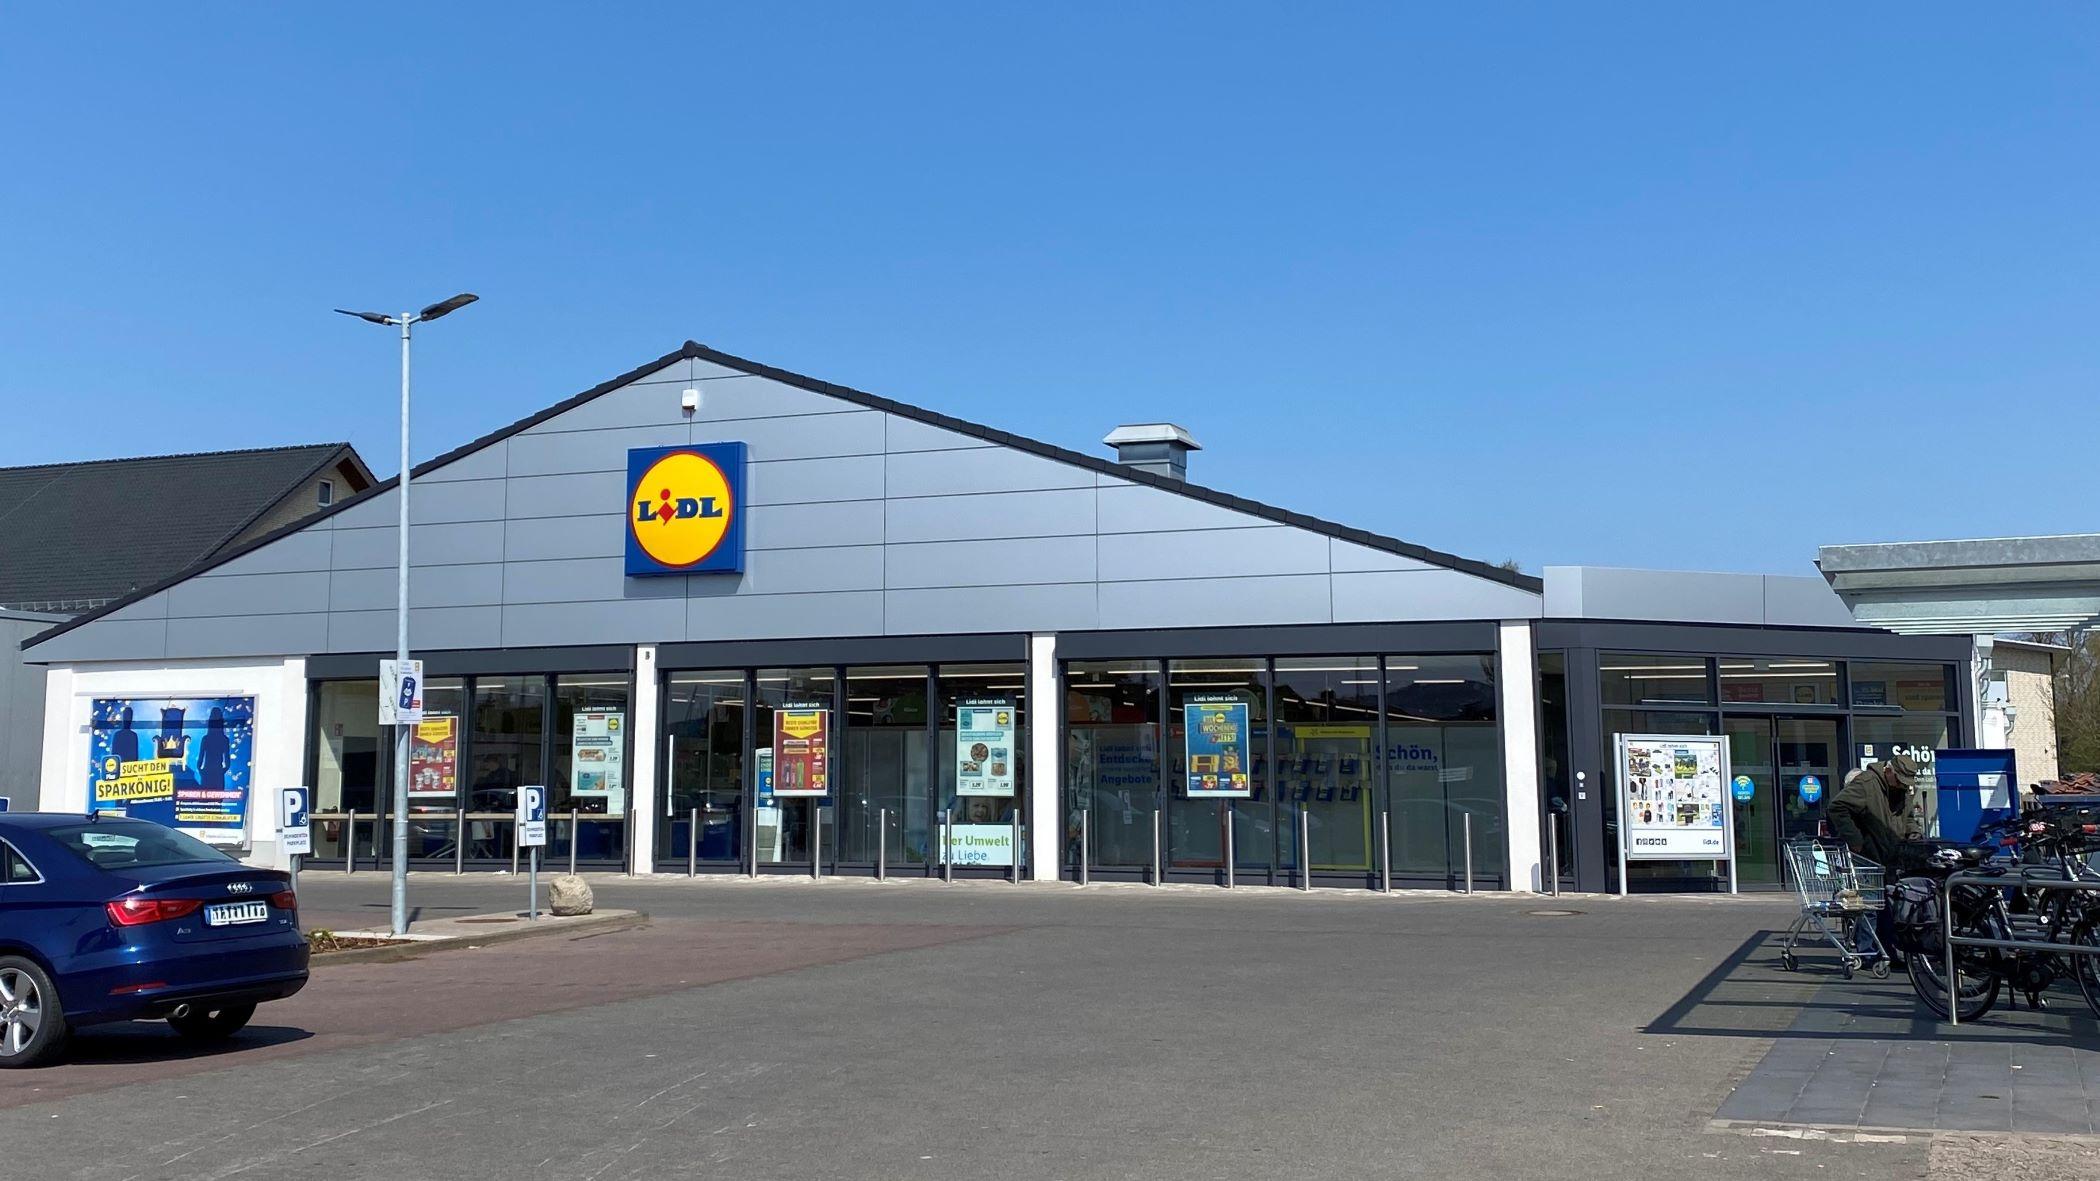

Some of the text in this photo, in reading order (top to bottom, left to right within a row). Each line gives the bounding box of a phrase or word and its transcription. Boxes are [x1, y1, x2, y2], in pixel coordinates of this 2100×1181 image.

[637, 489, 722, 526] LIDL
[122, 762, 166, 774] SUCHT DEN
[98, 777, 171, 798] SPARKÖNIG!
[284, 790, 302, 827] P
[526, 788, 540, 821] P
[965, 835, 1010, 847] Umwelt
